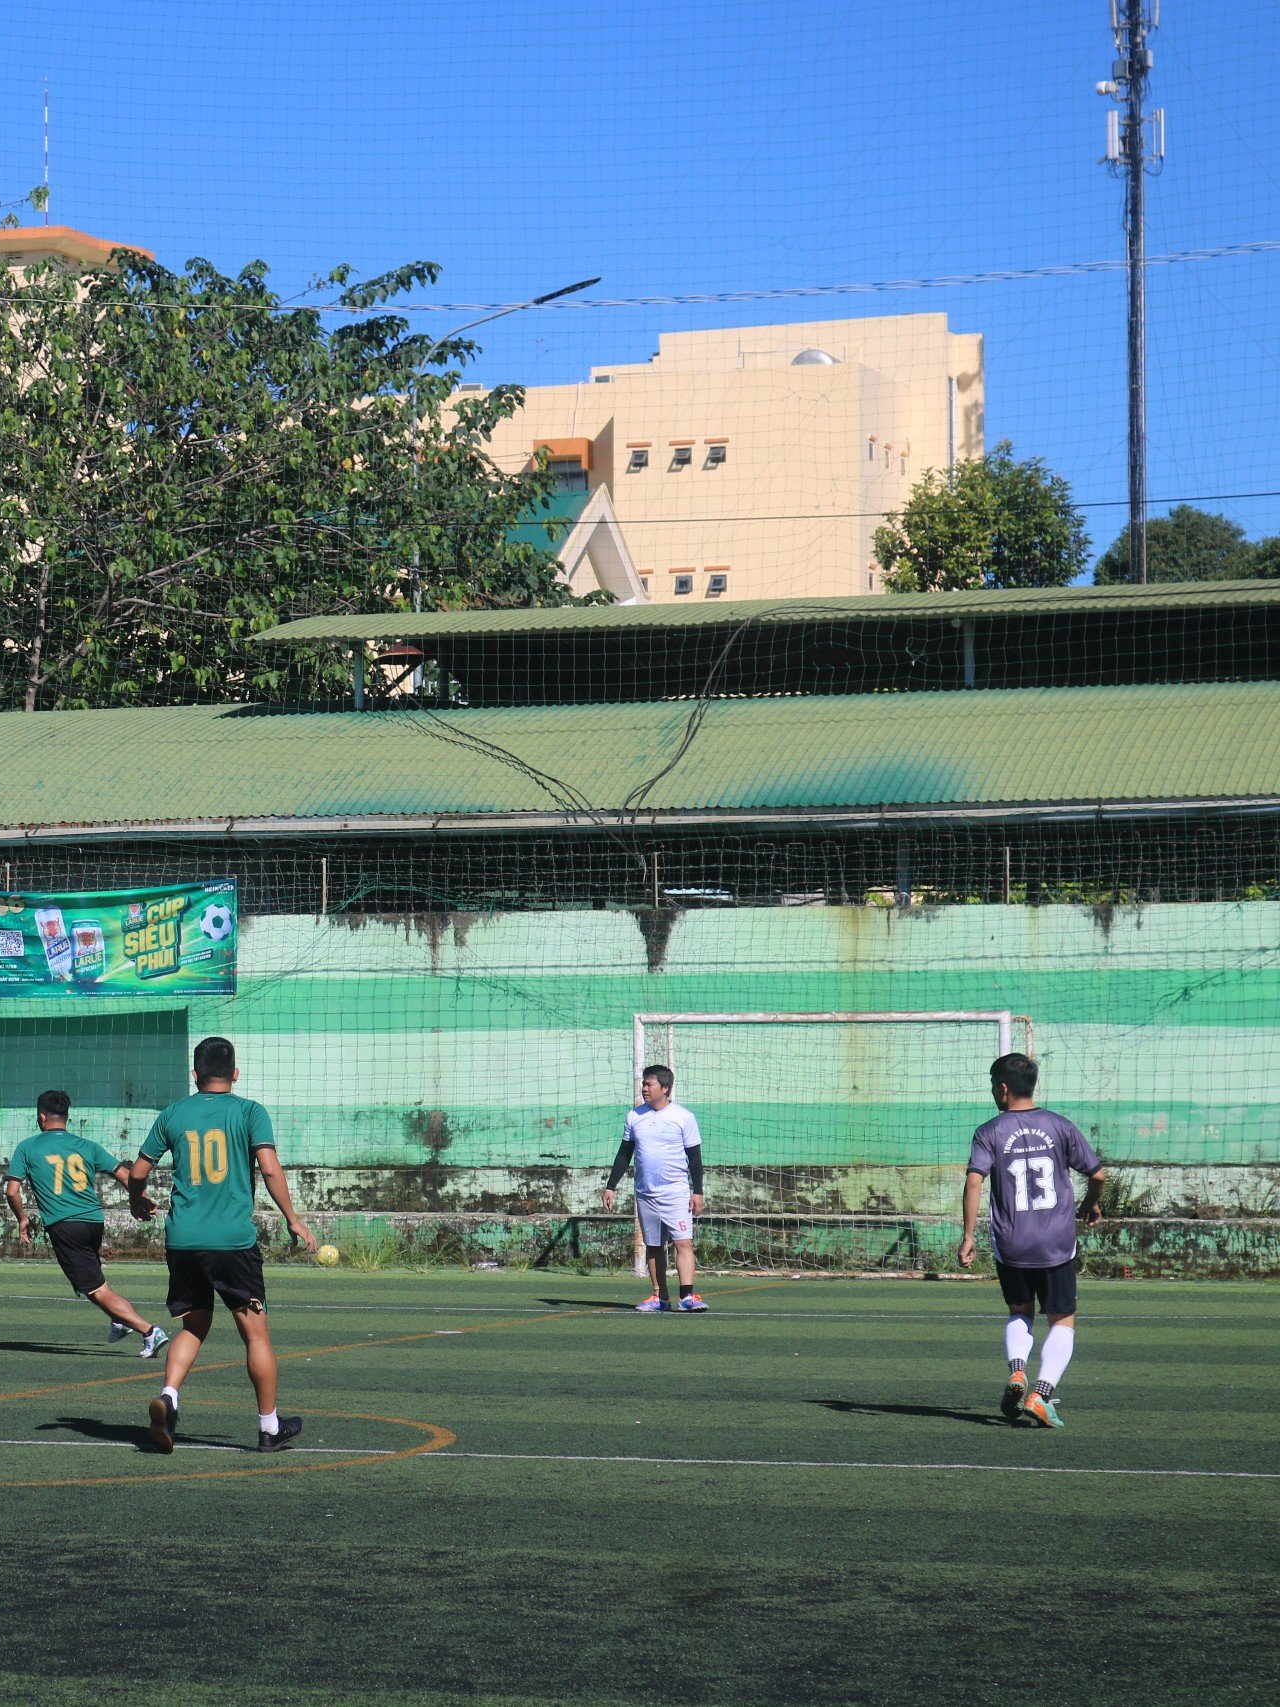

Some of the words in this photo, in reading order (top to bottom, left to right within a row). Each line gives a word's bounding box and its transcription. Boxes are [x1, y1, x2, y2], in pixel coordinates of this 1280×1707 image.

[147, 897, 184, 924] CÚP
[47, 940, 69, 958] LARUE
[125, 921, 175, 955] SIÊU
[74, 952, 103, 968] LARUE
[137, 947, 175, 974] PHỦI
[1003, 1134, 1017, 1154] TRUNG
[1014, 1128, 1030, 1138] TÂM
[185, 1129, 228, 1185] 10
[1007, 1156, 1058, 1212] 13
[678, 1220, 687, 1232] 6
